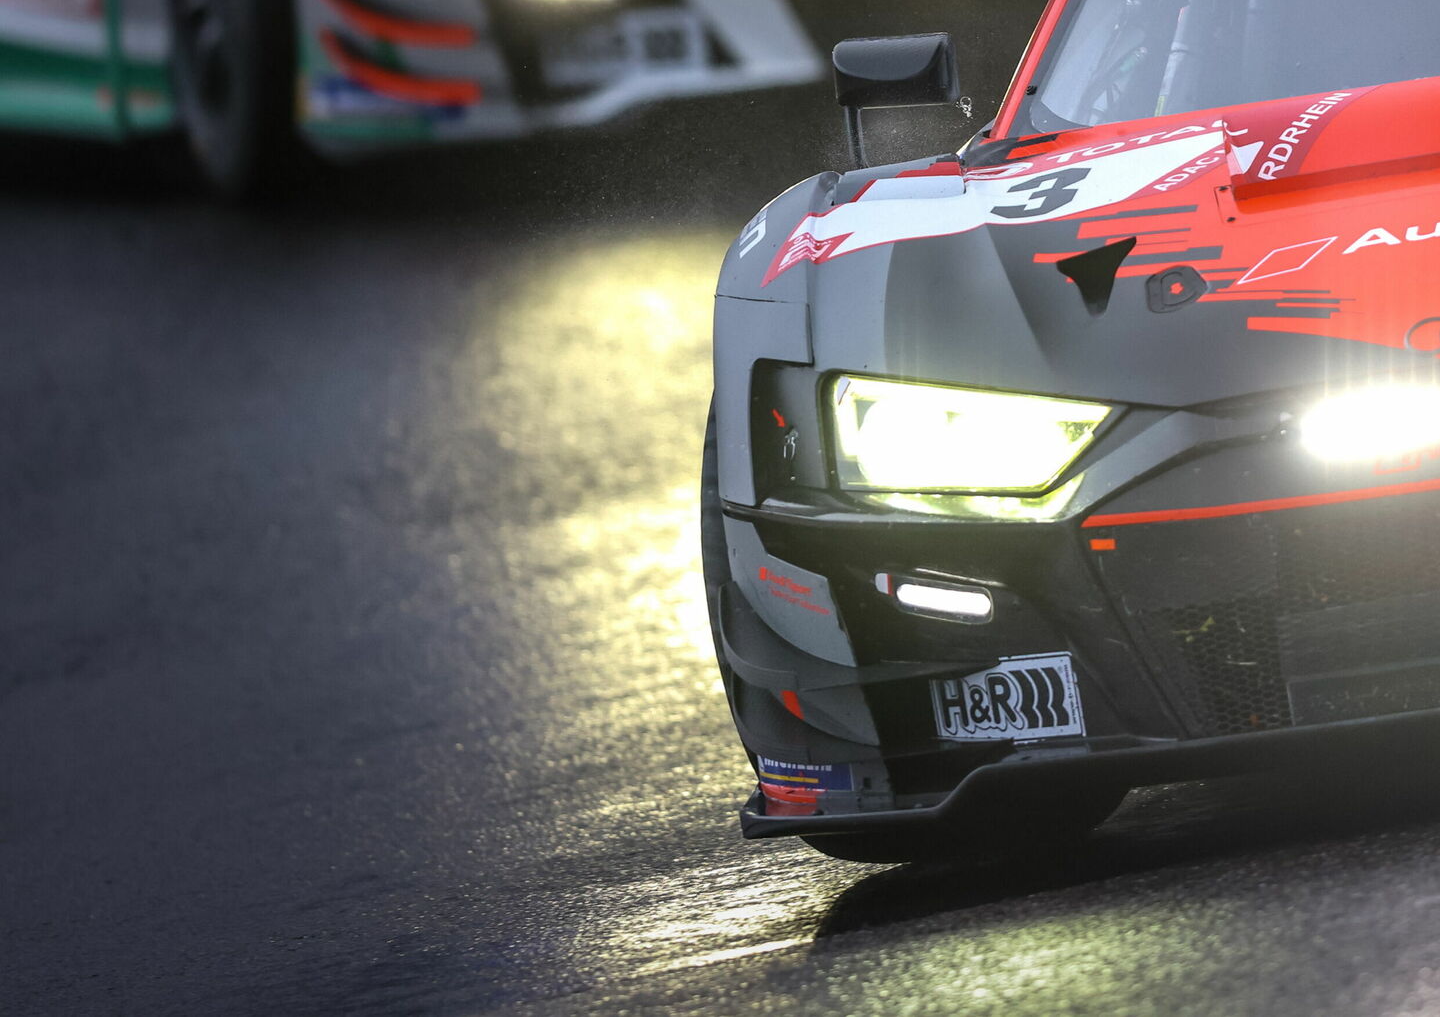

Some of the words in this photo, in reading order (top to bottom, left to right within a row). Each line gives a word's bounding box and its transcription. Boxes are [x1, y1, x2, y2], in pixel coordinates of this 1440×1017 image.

[1152, 156, 1221, 192] ADAC
[1257, 92, 1353, 181] RDRHEIN
[990, 167, 1092, 219] 3
[939, 674, 1019, 731] H&R
